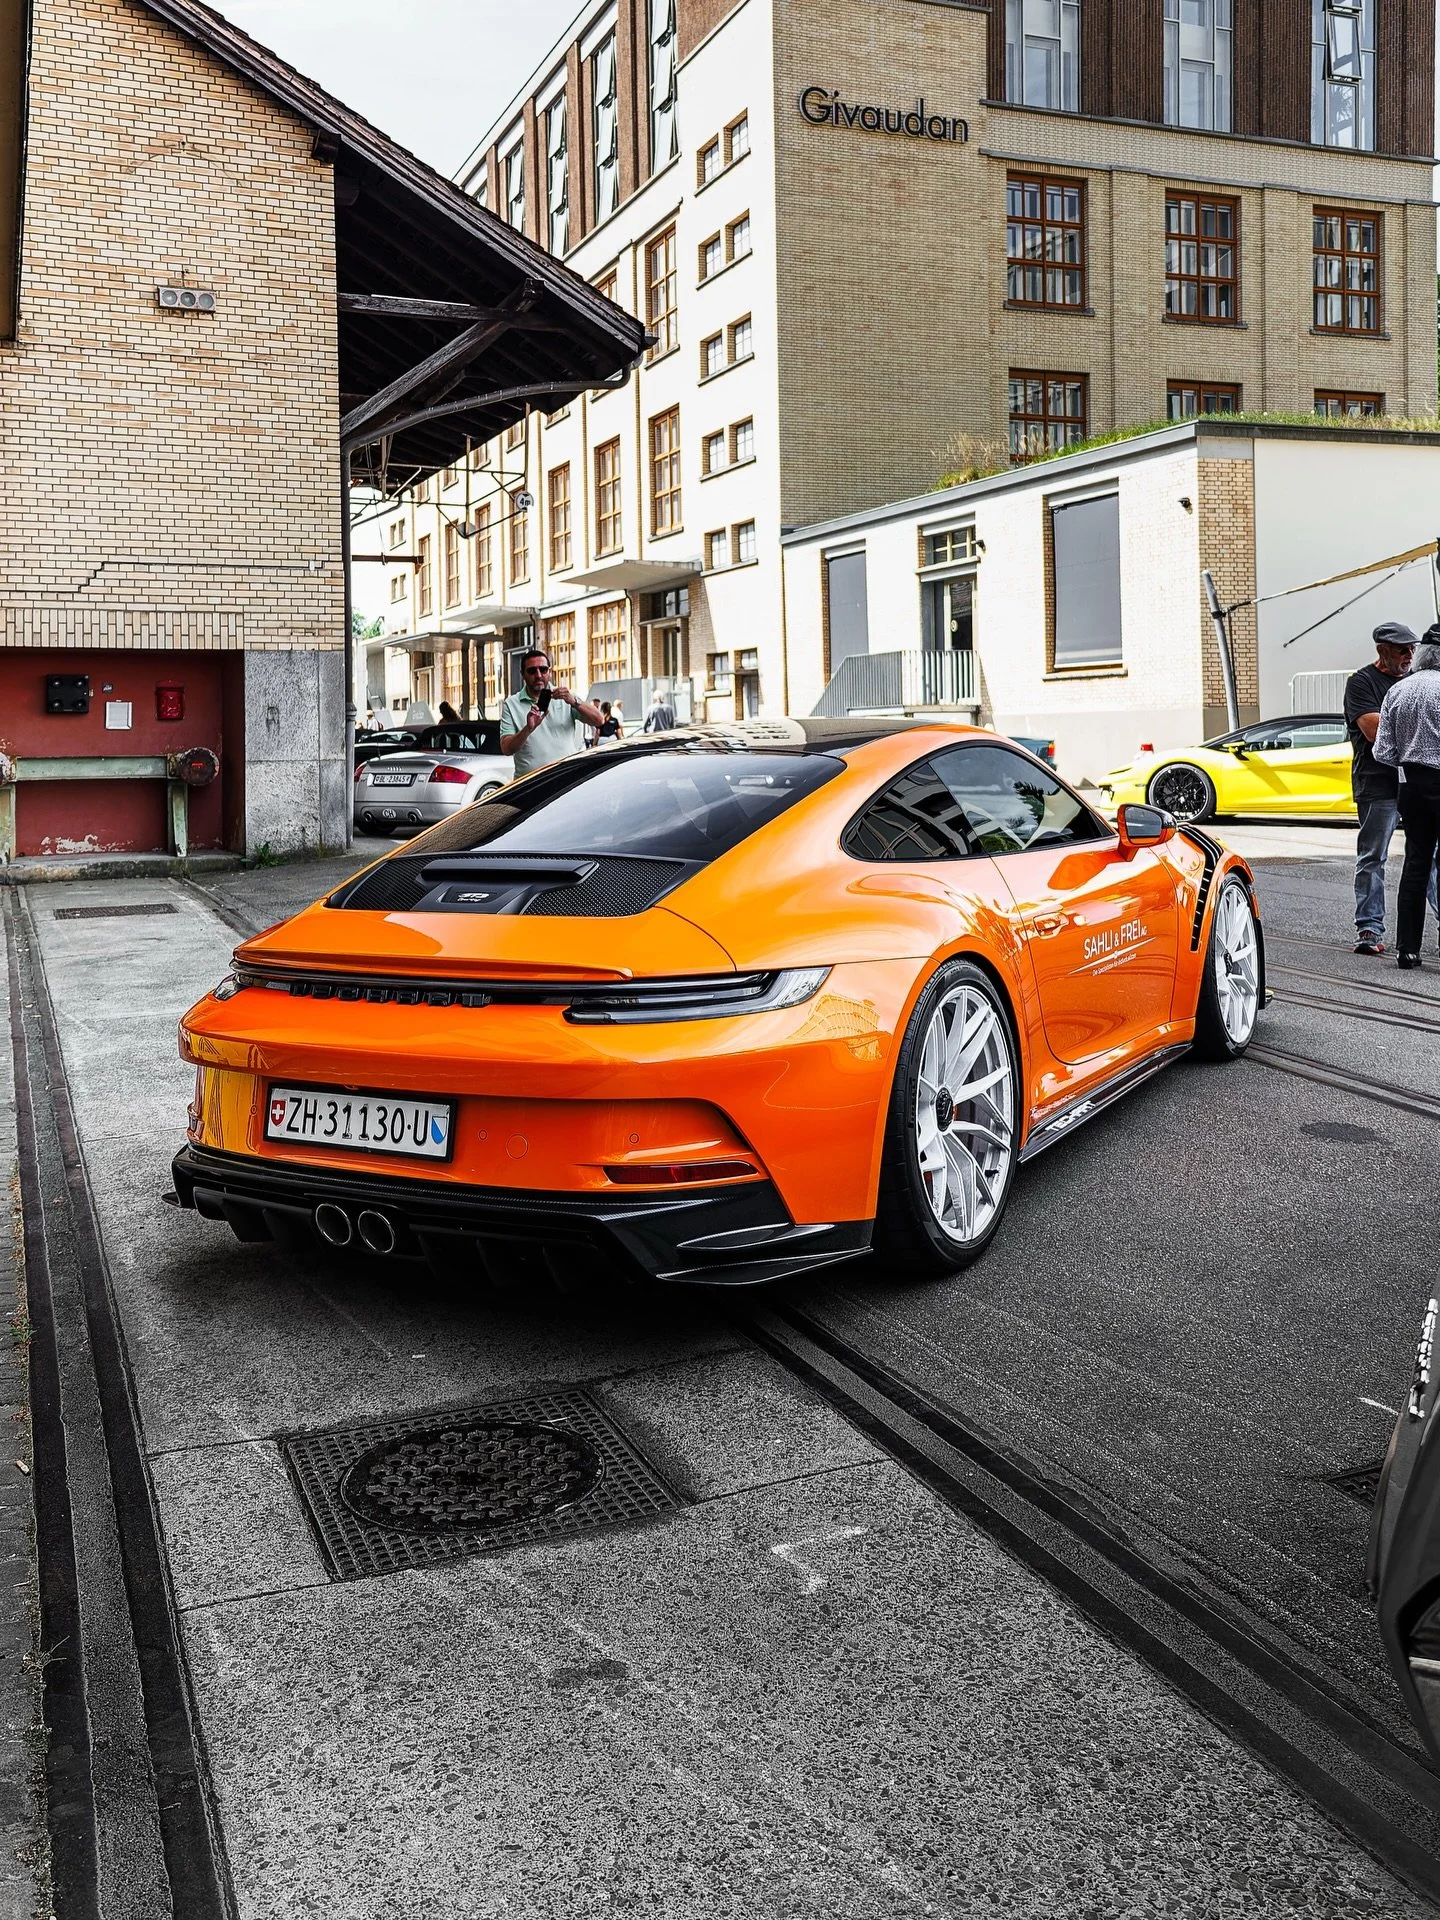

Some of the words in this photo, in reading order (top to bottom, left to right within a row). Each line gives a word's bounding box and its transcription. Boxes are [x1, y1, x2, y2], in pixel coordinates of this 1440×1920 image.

[800, 86, 968, 143] Givaudan
[1084, 929, 1113, 960] SAHLI
[1114, 932, 1119, 947] &
[1120, 918, 1141, 945] FREI
[1045, 1100, 1096, 1131] TECHART
